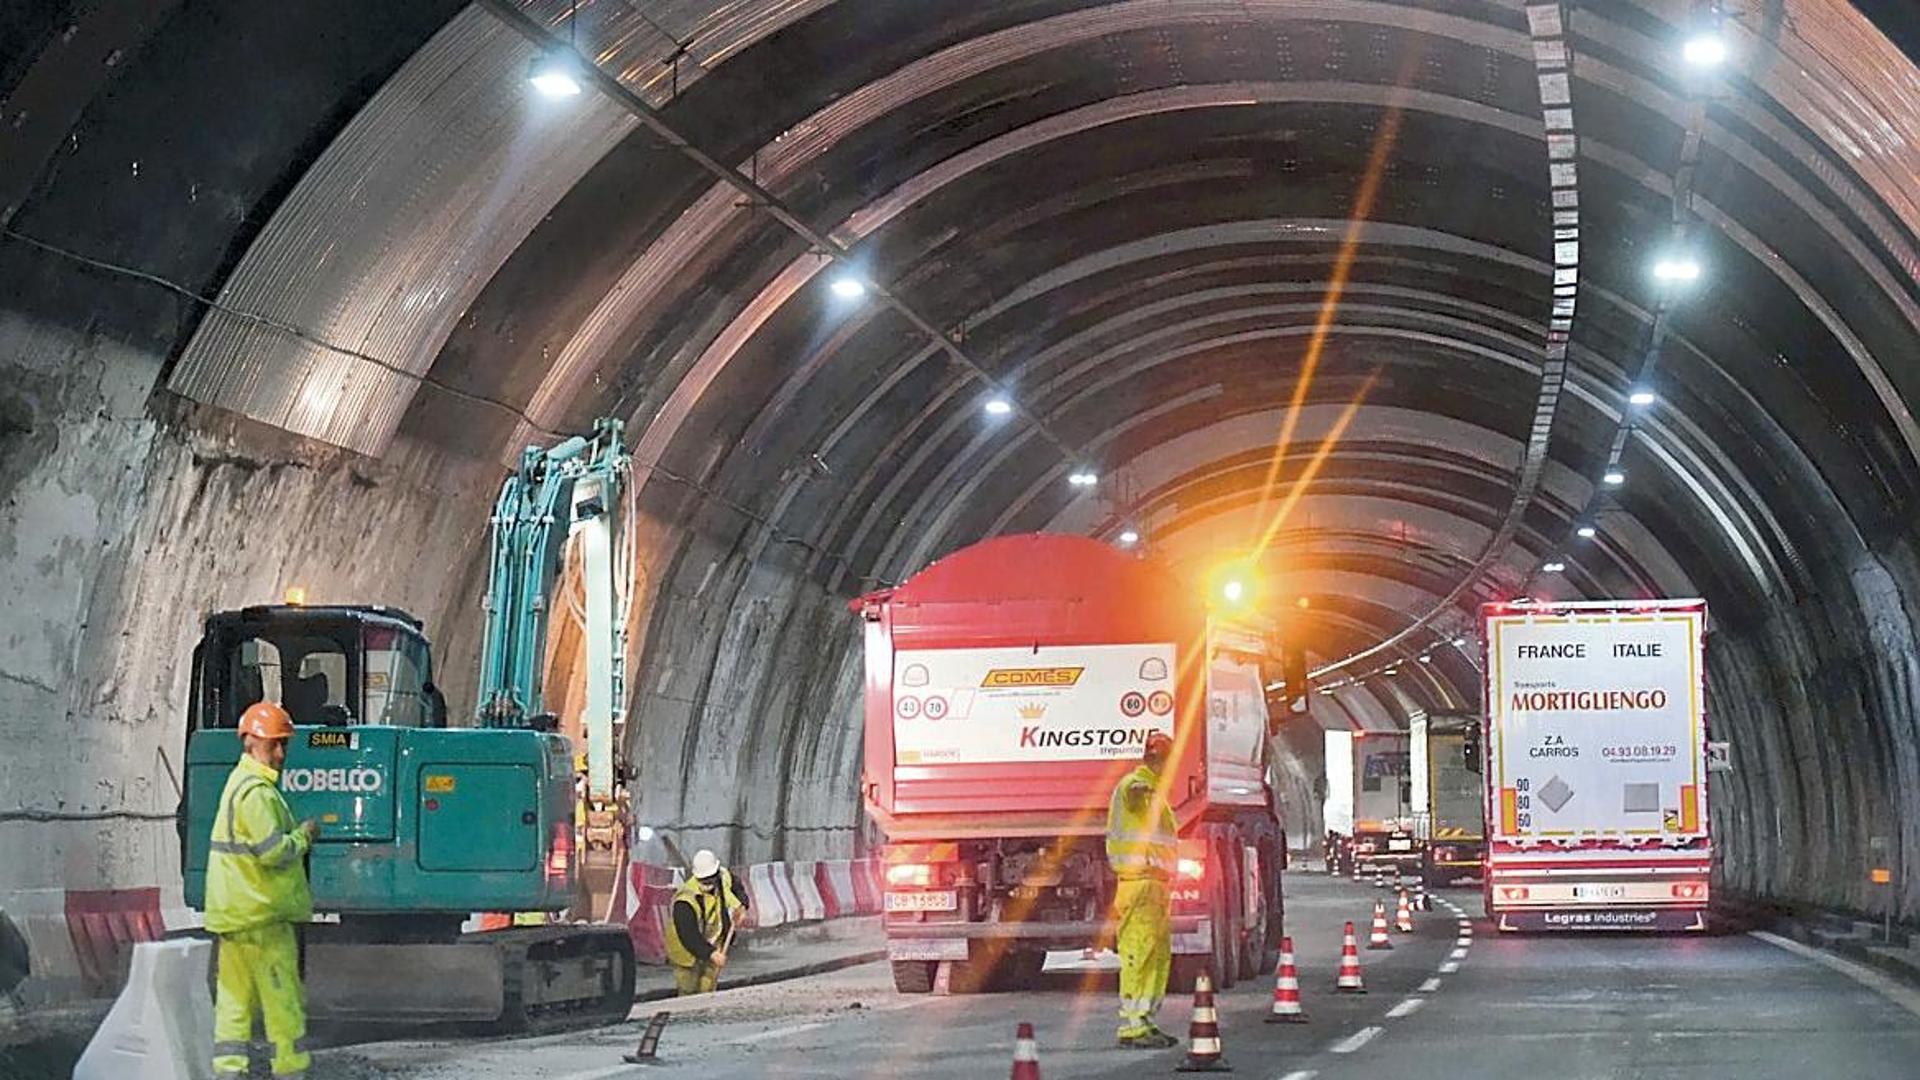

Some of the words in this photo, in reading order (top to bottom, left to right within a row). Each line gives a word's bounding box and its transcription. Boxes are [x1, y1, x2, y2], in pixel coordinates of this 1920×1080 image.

[1518, 644, 1586, 658] FRANCE
[1613, 643, 1662, 657] ITALIE
[1511, 690, 1667, 711] MORTIGLIENGO
[311, 733, 347, 746] SMIA
[1529, 747, 1579, 758] CARROS
[281, 768, 381, 792] KOBELCO
[1516, 778, 1530, 792] 90
[1545, 912, 1592, 924] Legras
